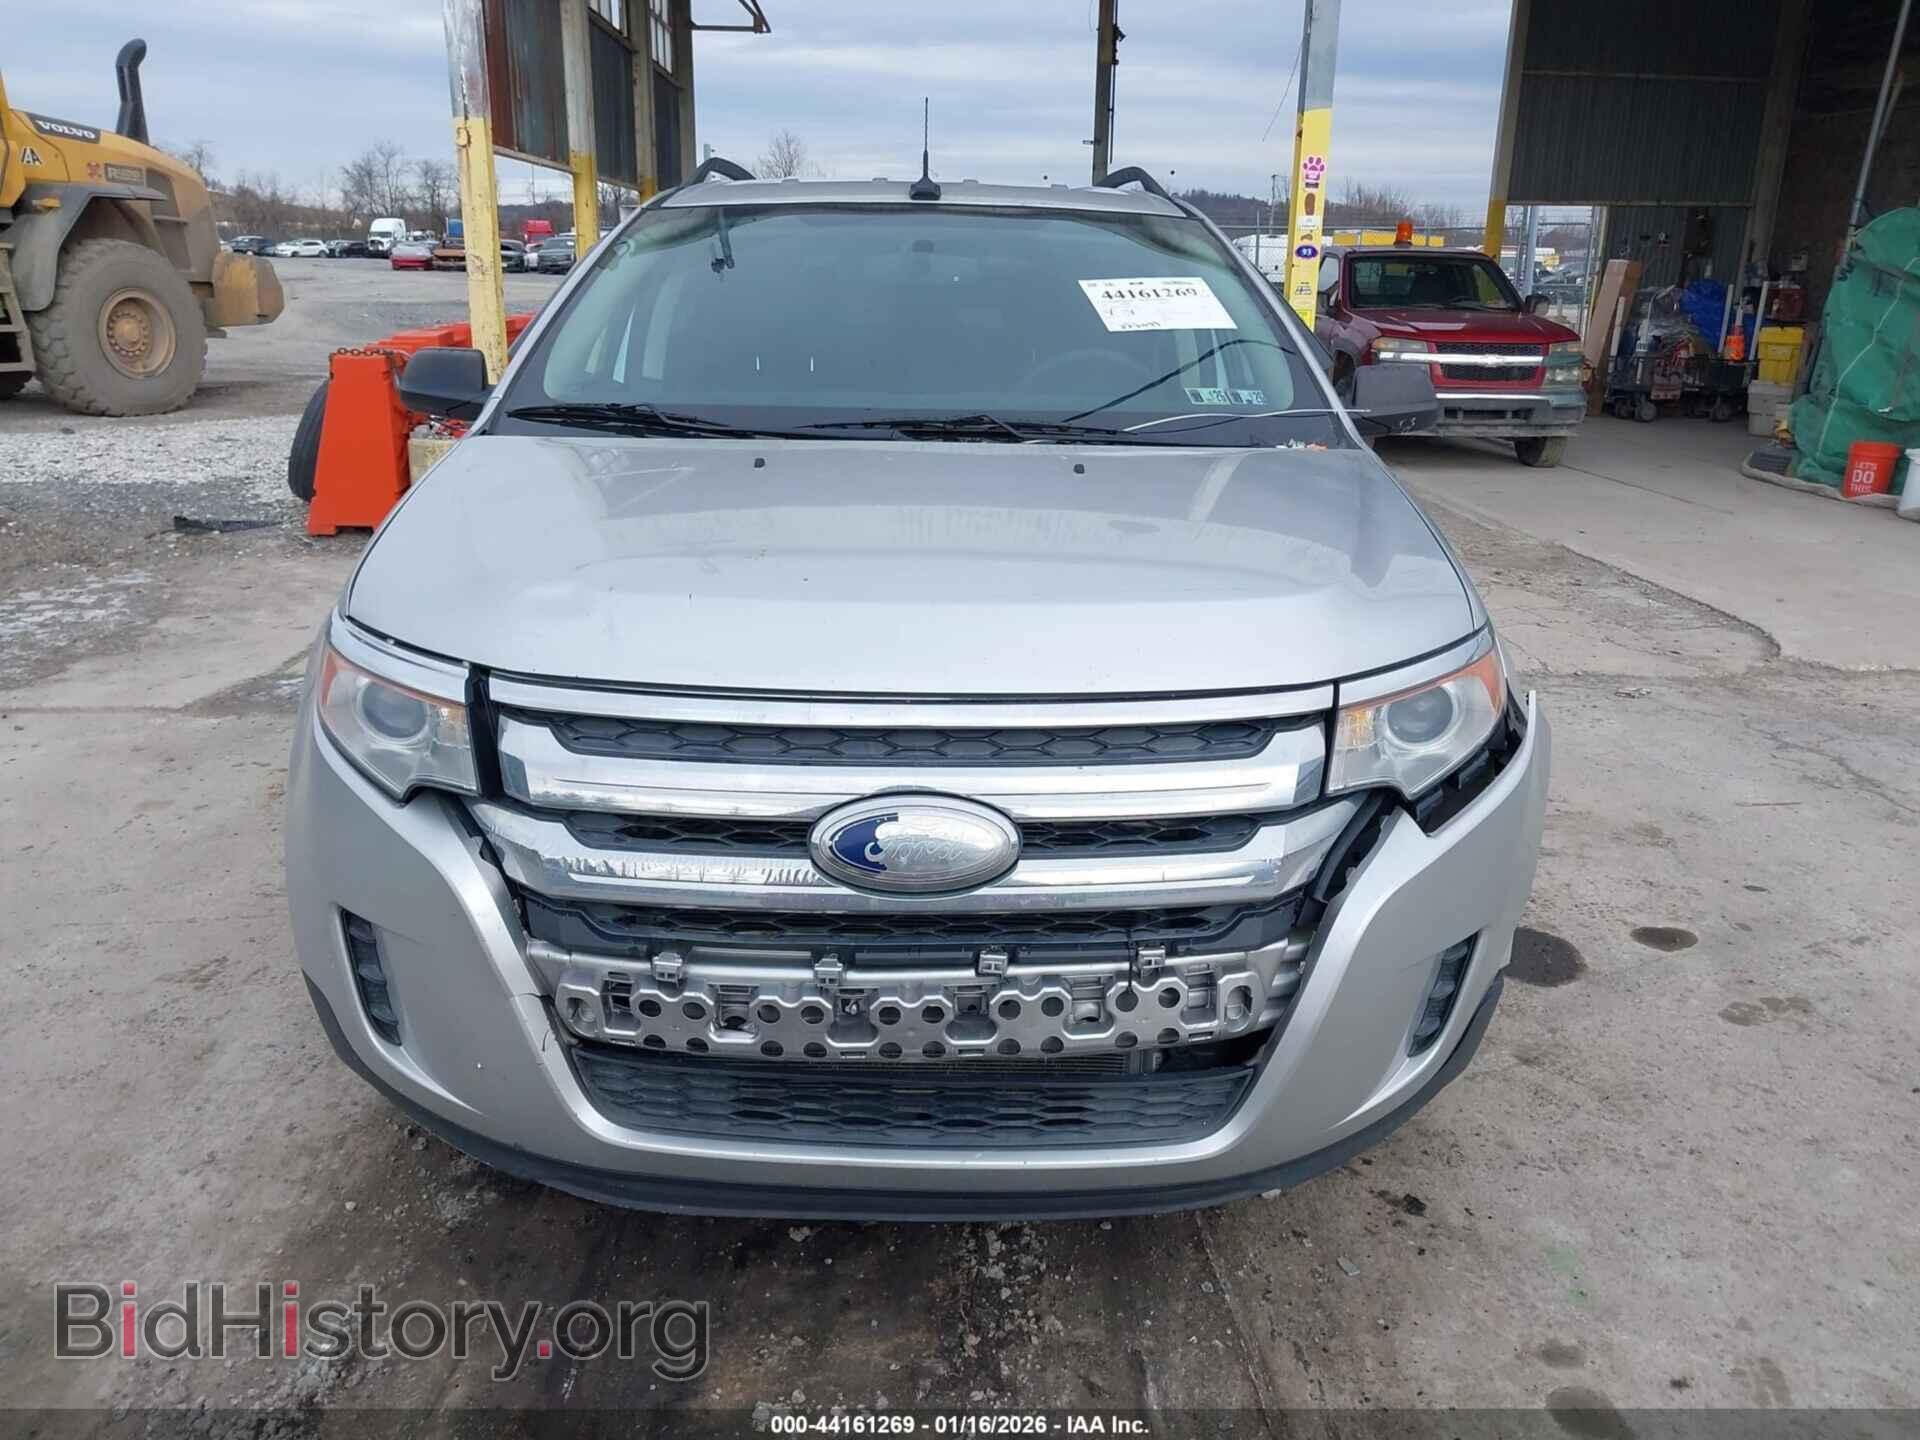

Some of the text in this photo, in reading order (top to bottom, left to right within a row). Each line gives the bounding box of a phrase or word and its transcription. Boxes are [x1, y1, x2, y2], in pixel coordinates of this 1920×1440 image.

[35, 119, 96, 139] VOLVO
[1101, 287, 1199, 301] 44161269
[1852, 469, 1875, 484] DO
